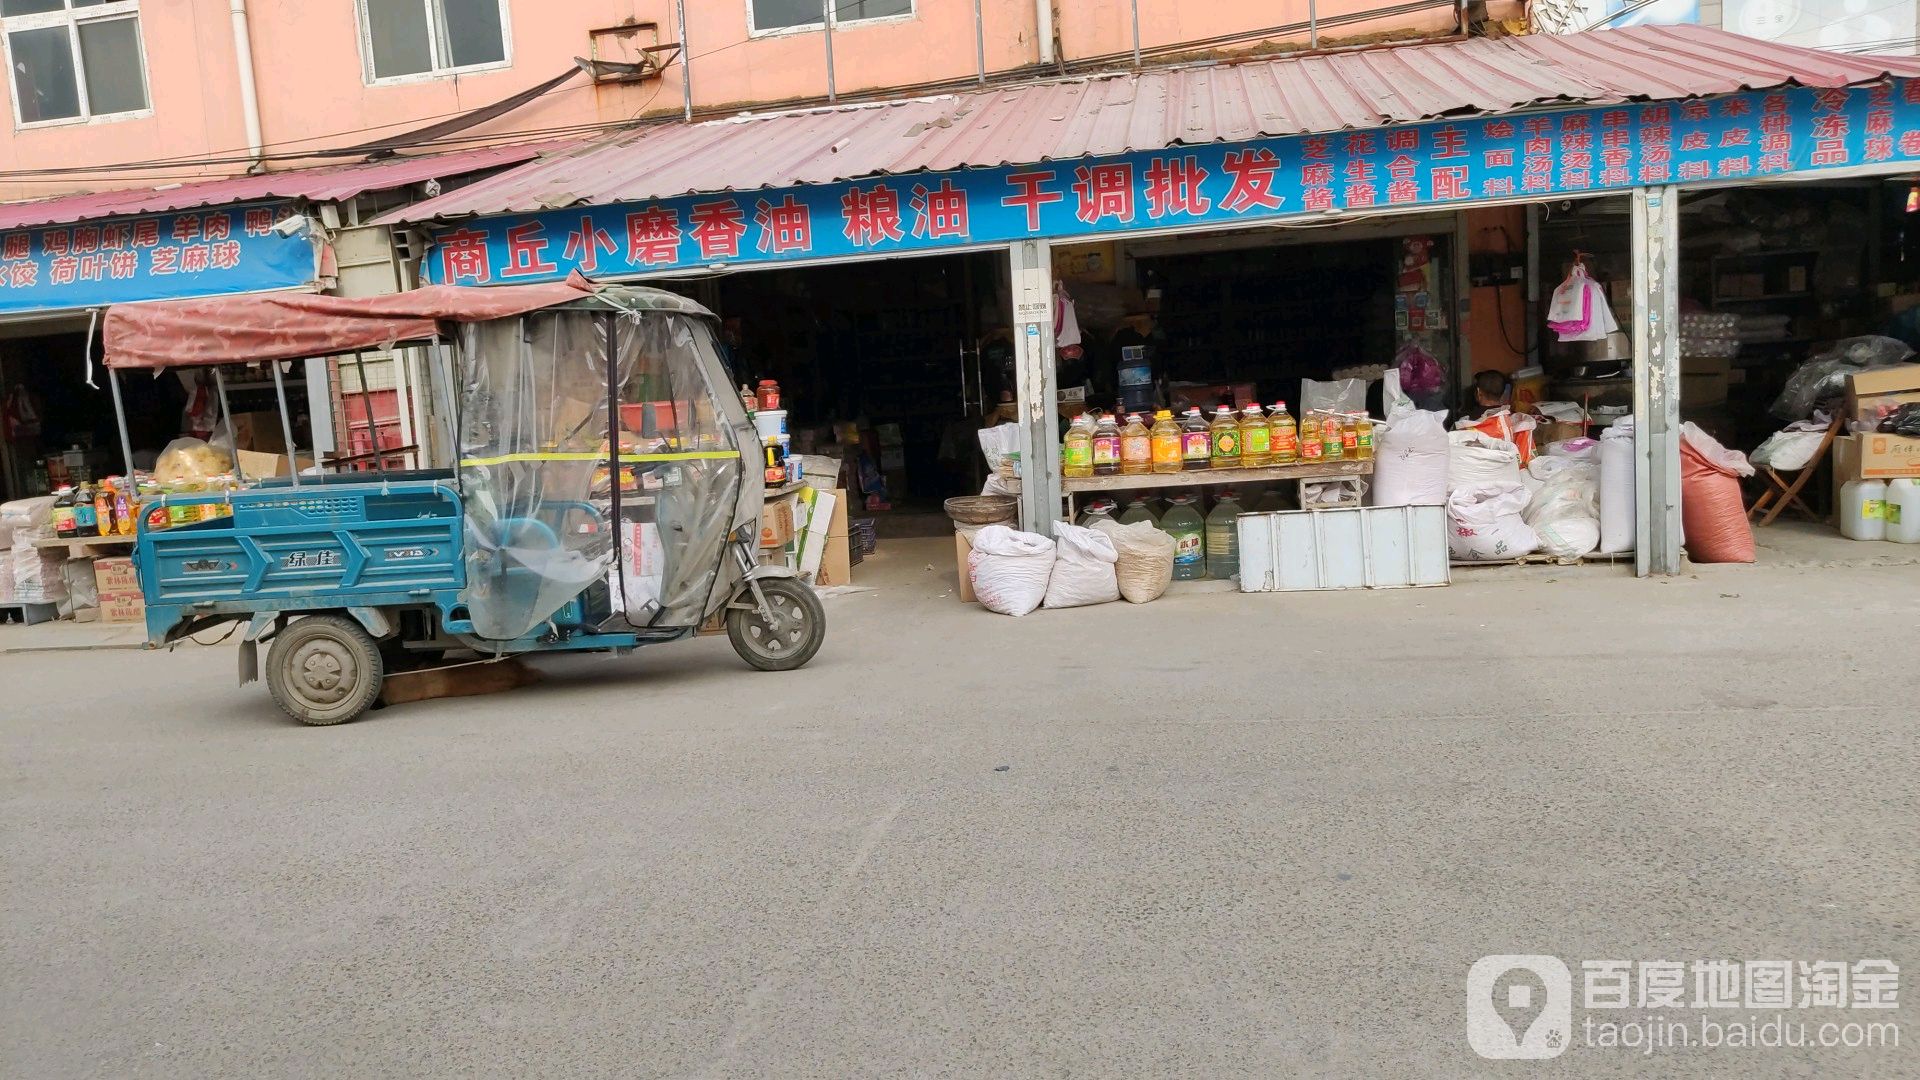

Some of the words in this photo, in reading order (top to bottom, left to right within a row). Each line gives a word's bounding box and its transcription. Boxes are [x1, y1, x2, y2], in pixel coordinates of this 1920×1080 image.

[1483, 119, 1515, 196] 烩面料
[1521, 117, 1554, 194] 羊肉汤料
[1560, 113, 1594, 190] 麻辣烫料
[1599, 110, 1632, 187] 串串香料
[1638, 104, 1672, 184] 胡辣汤料
[1678, 101, 1711, 180] 凉皮料
[1717, 97, 1751, 177] 米皮料
[1758, 94, 1792, 172] 各种调料
[1810, 88, 1851, 166] 冷冻品
[1863, 84, 1895, 162] 芝麻球
[1300, 135, 1336, 212] 芝麻酱
[1342, 132, 1378, 209] 花生酱
[1385, 127, 1421, 205] 调合酱
[1430, 125, 1471, 200] 主配
[42, 220, 160, 257] 鸡胸虾尾
[171, 212, 231, 242] 羊肉
[437, 194, 812, 285] 商丘小磨香油
[841, 179, 970, 247] 粮油
[1001, 147, 1286, 232] 干调批发
[50, 250, 138, 285] 荷叶饼
[150, 240, 241, 276] 芝麻球
[289, 550, 336, 567] 绿佳
